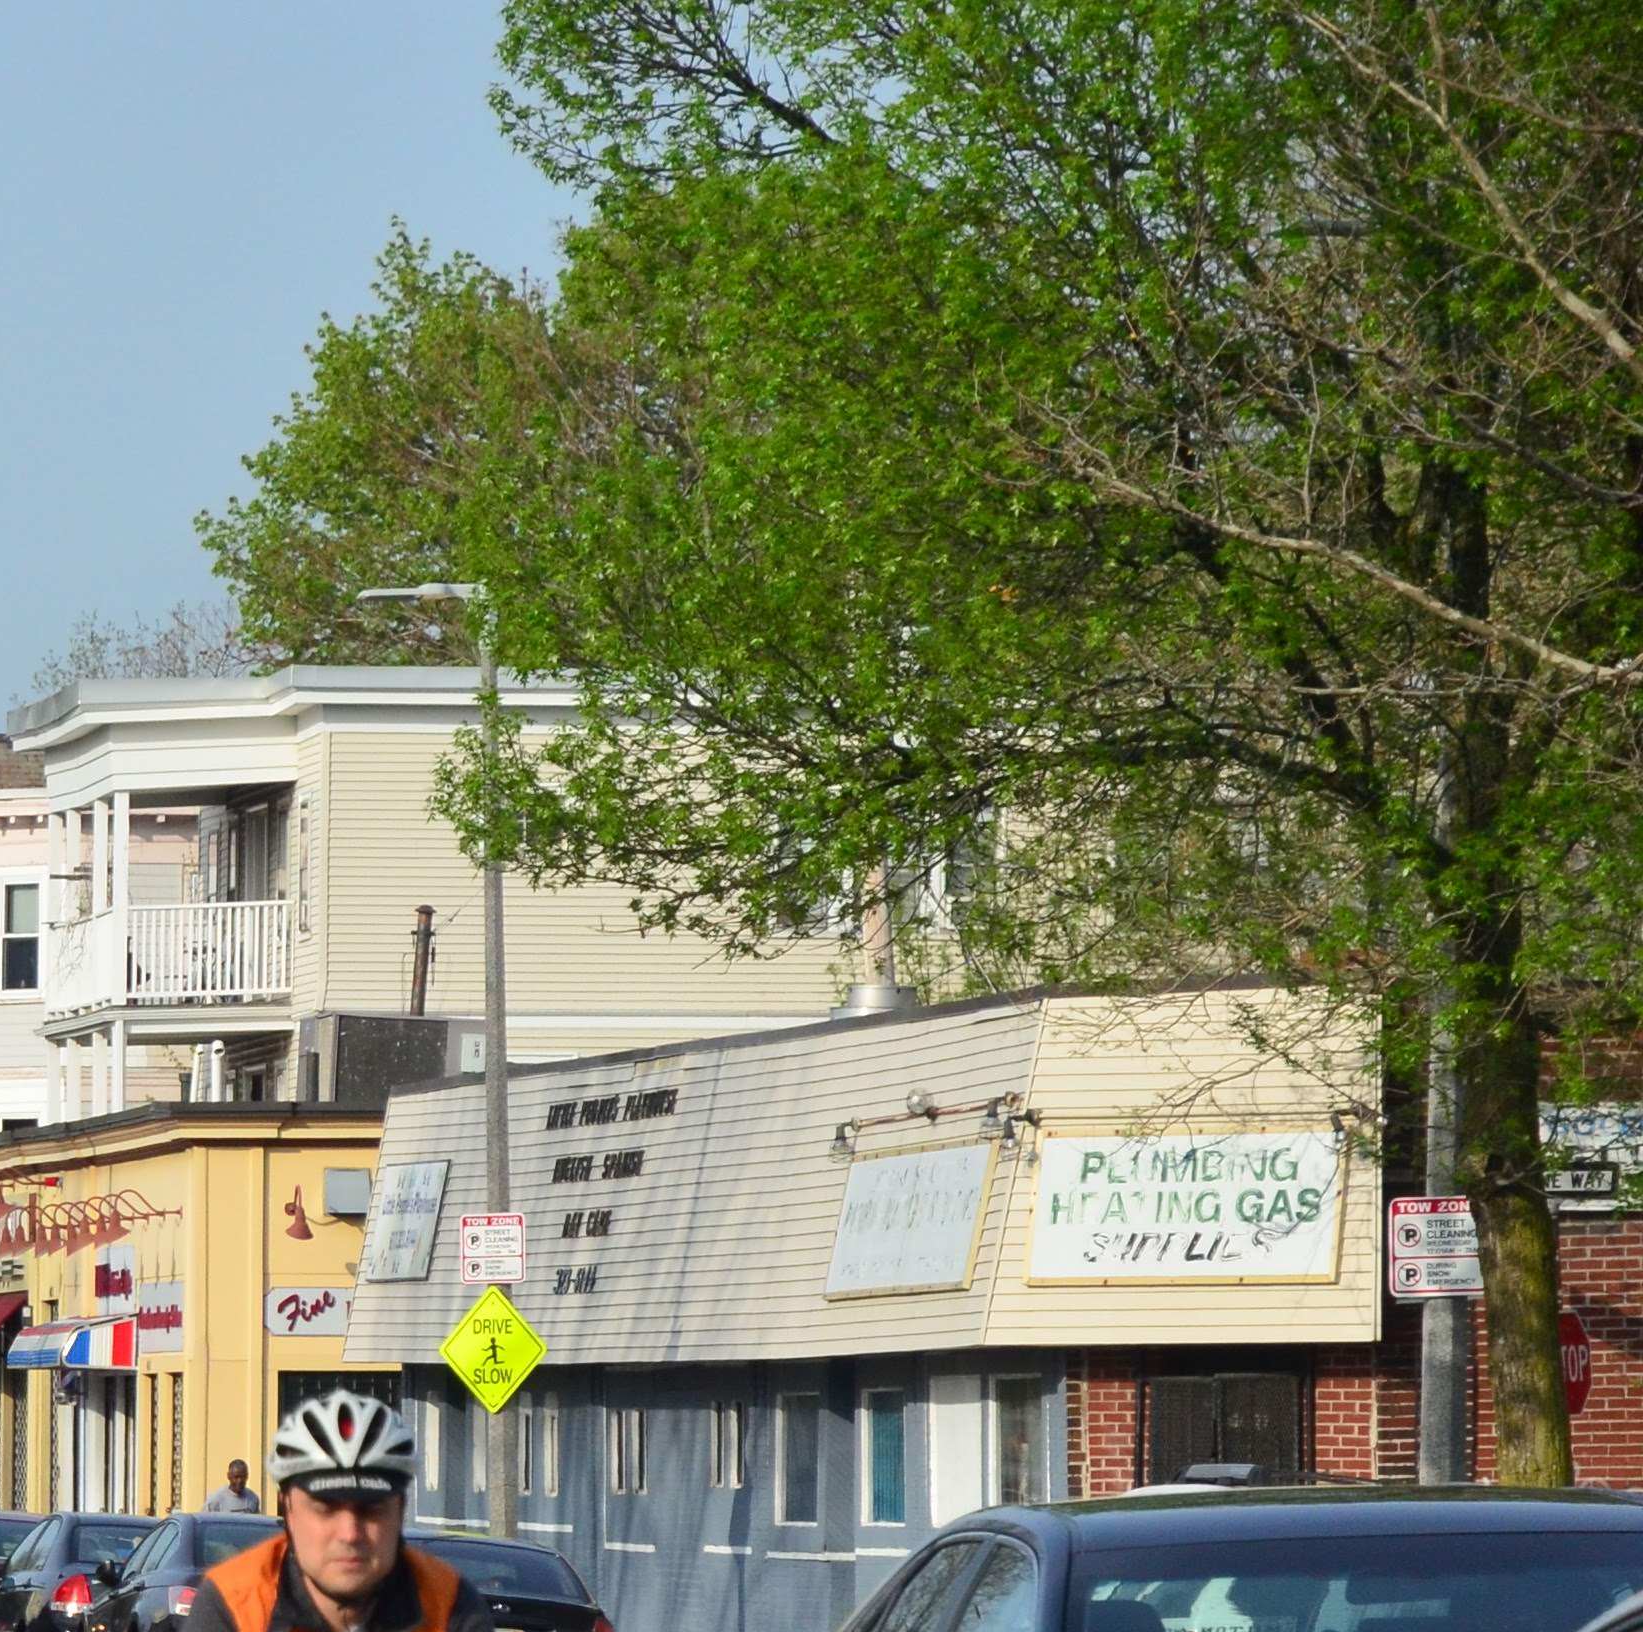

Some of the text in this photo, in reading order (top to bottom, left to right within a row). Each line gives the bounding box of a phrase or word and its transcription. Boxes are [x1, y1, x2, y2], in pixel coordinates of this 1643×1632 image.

[1235, 1187, 1323, 1224] GAS
[1397, 1200, 1471, 1214] TOW ZON
[465, 1216, 520, 1227] TOW ZONE
[1426, 1219, 1467, 1229] STREET
[277, 1291, 336, 1332] Fine
[473, 1319, 514, 1335] DRIVE
[1560, 1344, 1589, 1382] TOP
[473, 1368, 514, 1385] SLOW
